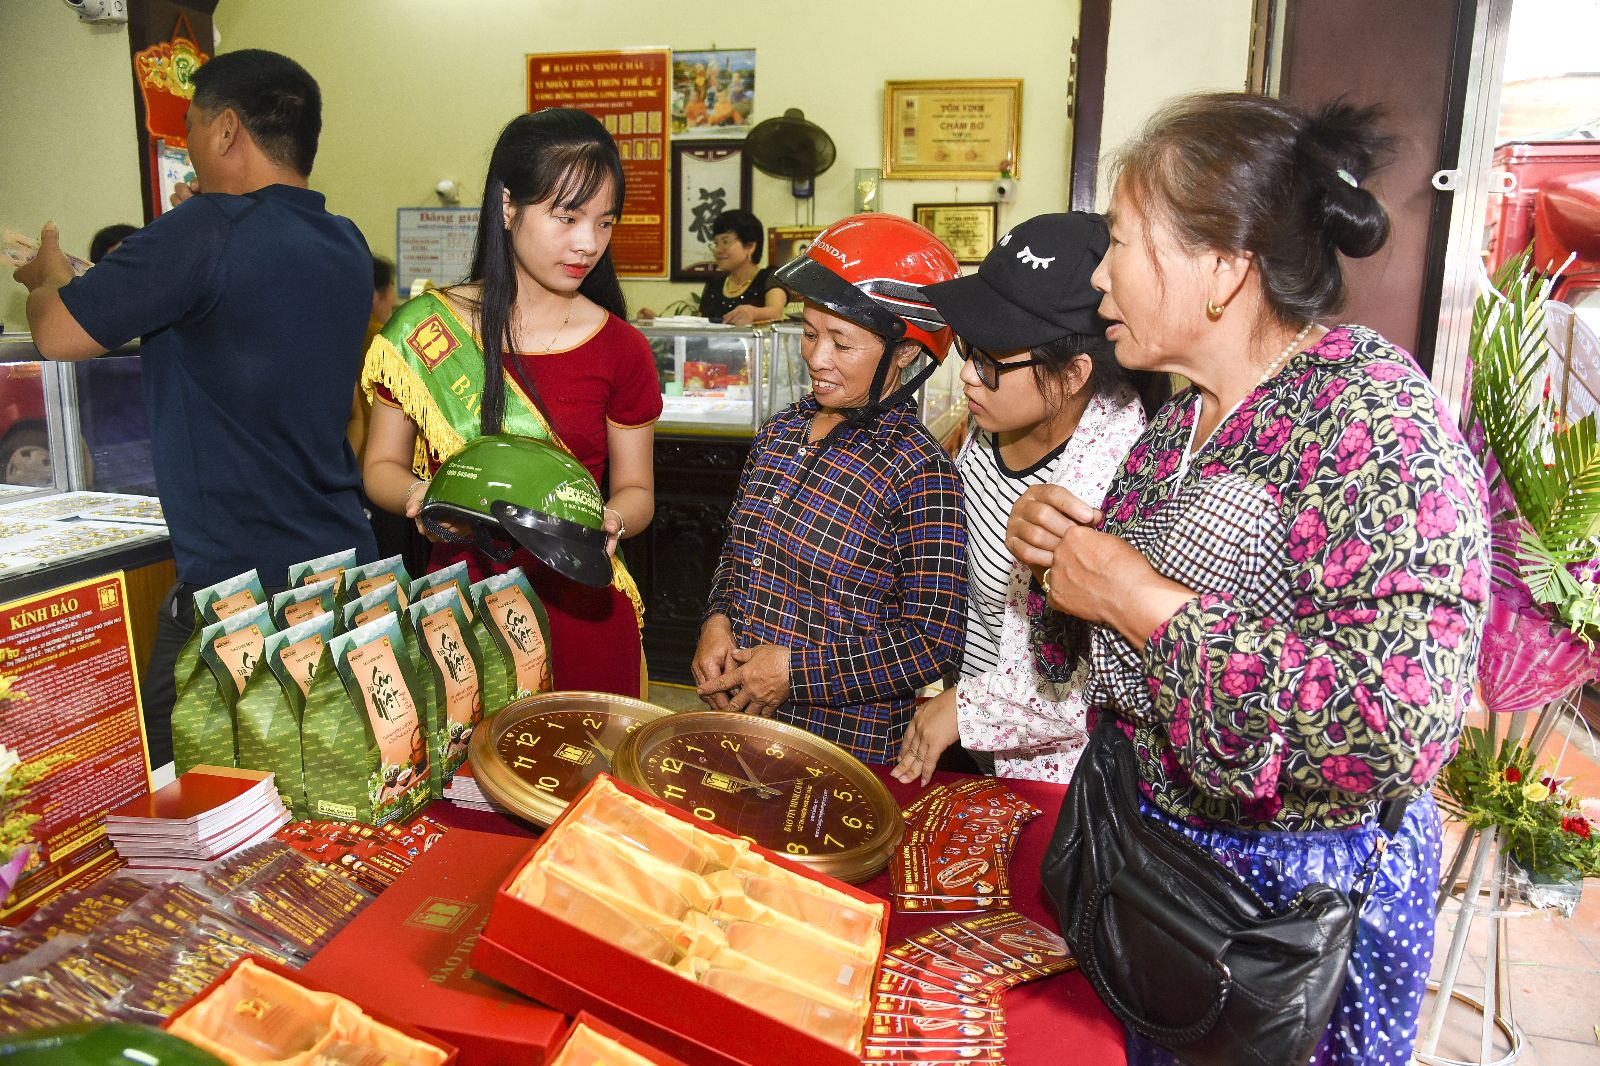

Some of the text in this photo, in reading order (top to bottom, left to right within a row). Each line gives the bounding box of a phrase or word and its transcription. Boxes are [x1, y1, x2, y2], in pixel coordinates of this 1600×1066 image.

[9, 597, 78, 631] KÍNH BÁO
[583, 717, 603, 731] 2
[515, 731, 542, 749] 12
[721, 739, 741, 754] 2
[765, 744, 785, 760] 3
[512, 753, 538, 770] 11
[806, 766, 823, 777] 4
[535, 776, 560, 793] 10
[663, 783, 688, 800] 11
[833, 788, 854, 803] 5
[841, 815, 862, 829] 6
[786, 841, 809, 855] 8
[823, 833, 845, 849] 7
